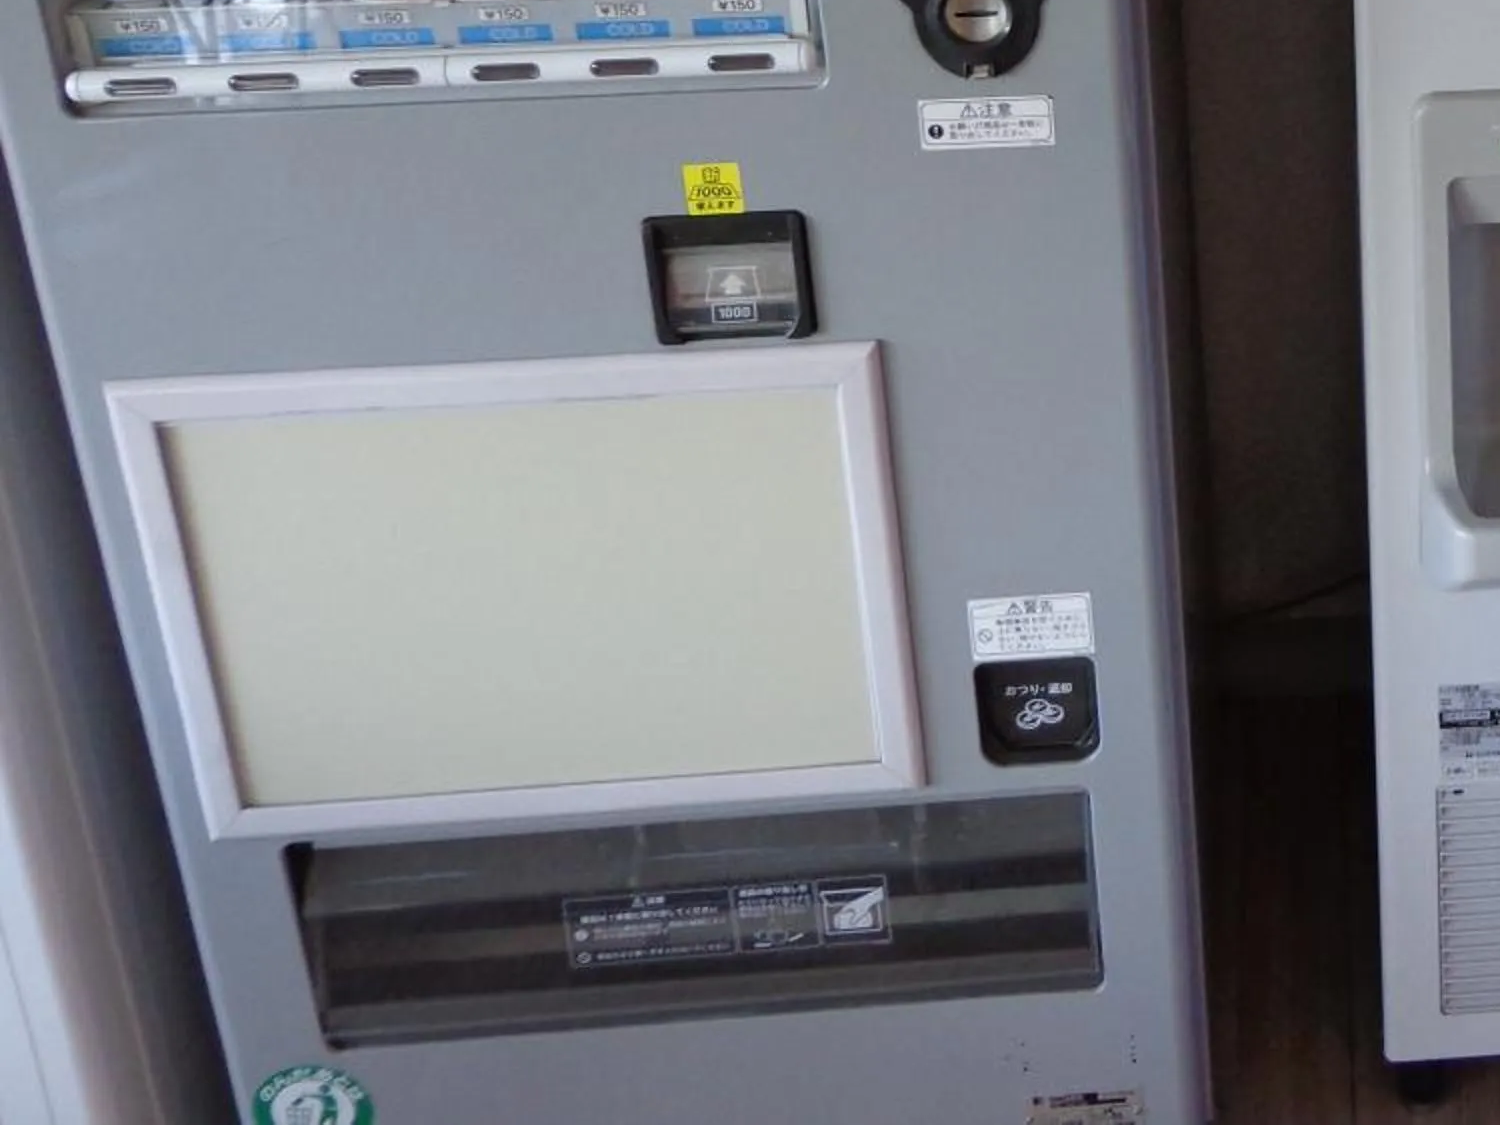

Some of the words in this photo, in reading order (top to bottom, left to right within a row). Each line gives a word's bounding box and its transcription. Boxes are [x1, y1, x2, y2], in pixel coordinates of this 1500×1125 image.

[601, 3, 638, 17] ¥150
[607, 23, 655, 37] COLD
[721, 20, 769, 34] COLD
[696, 186, 733, 198] 1000
[717, 306, 753, 320] 1000
